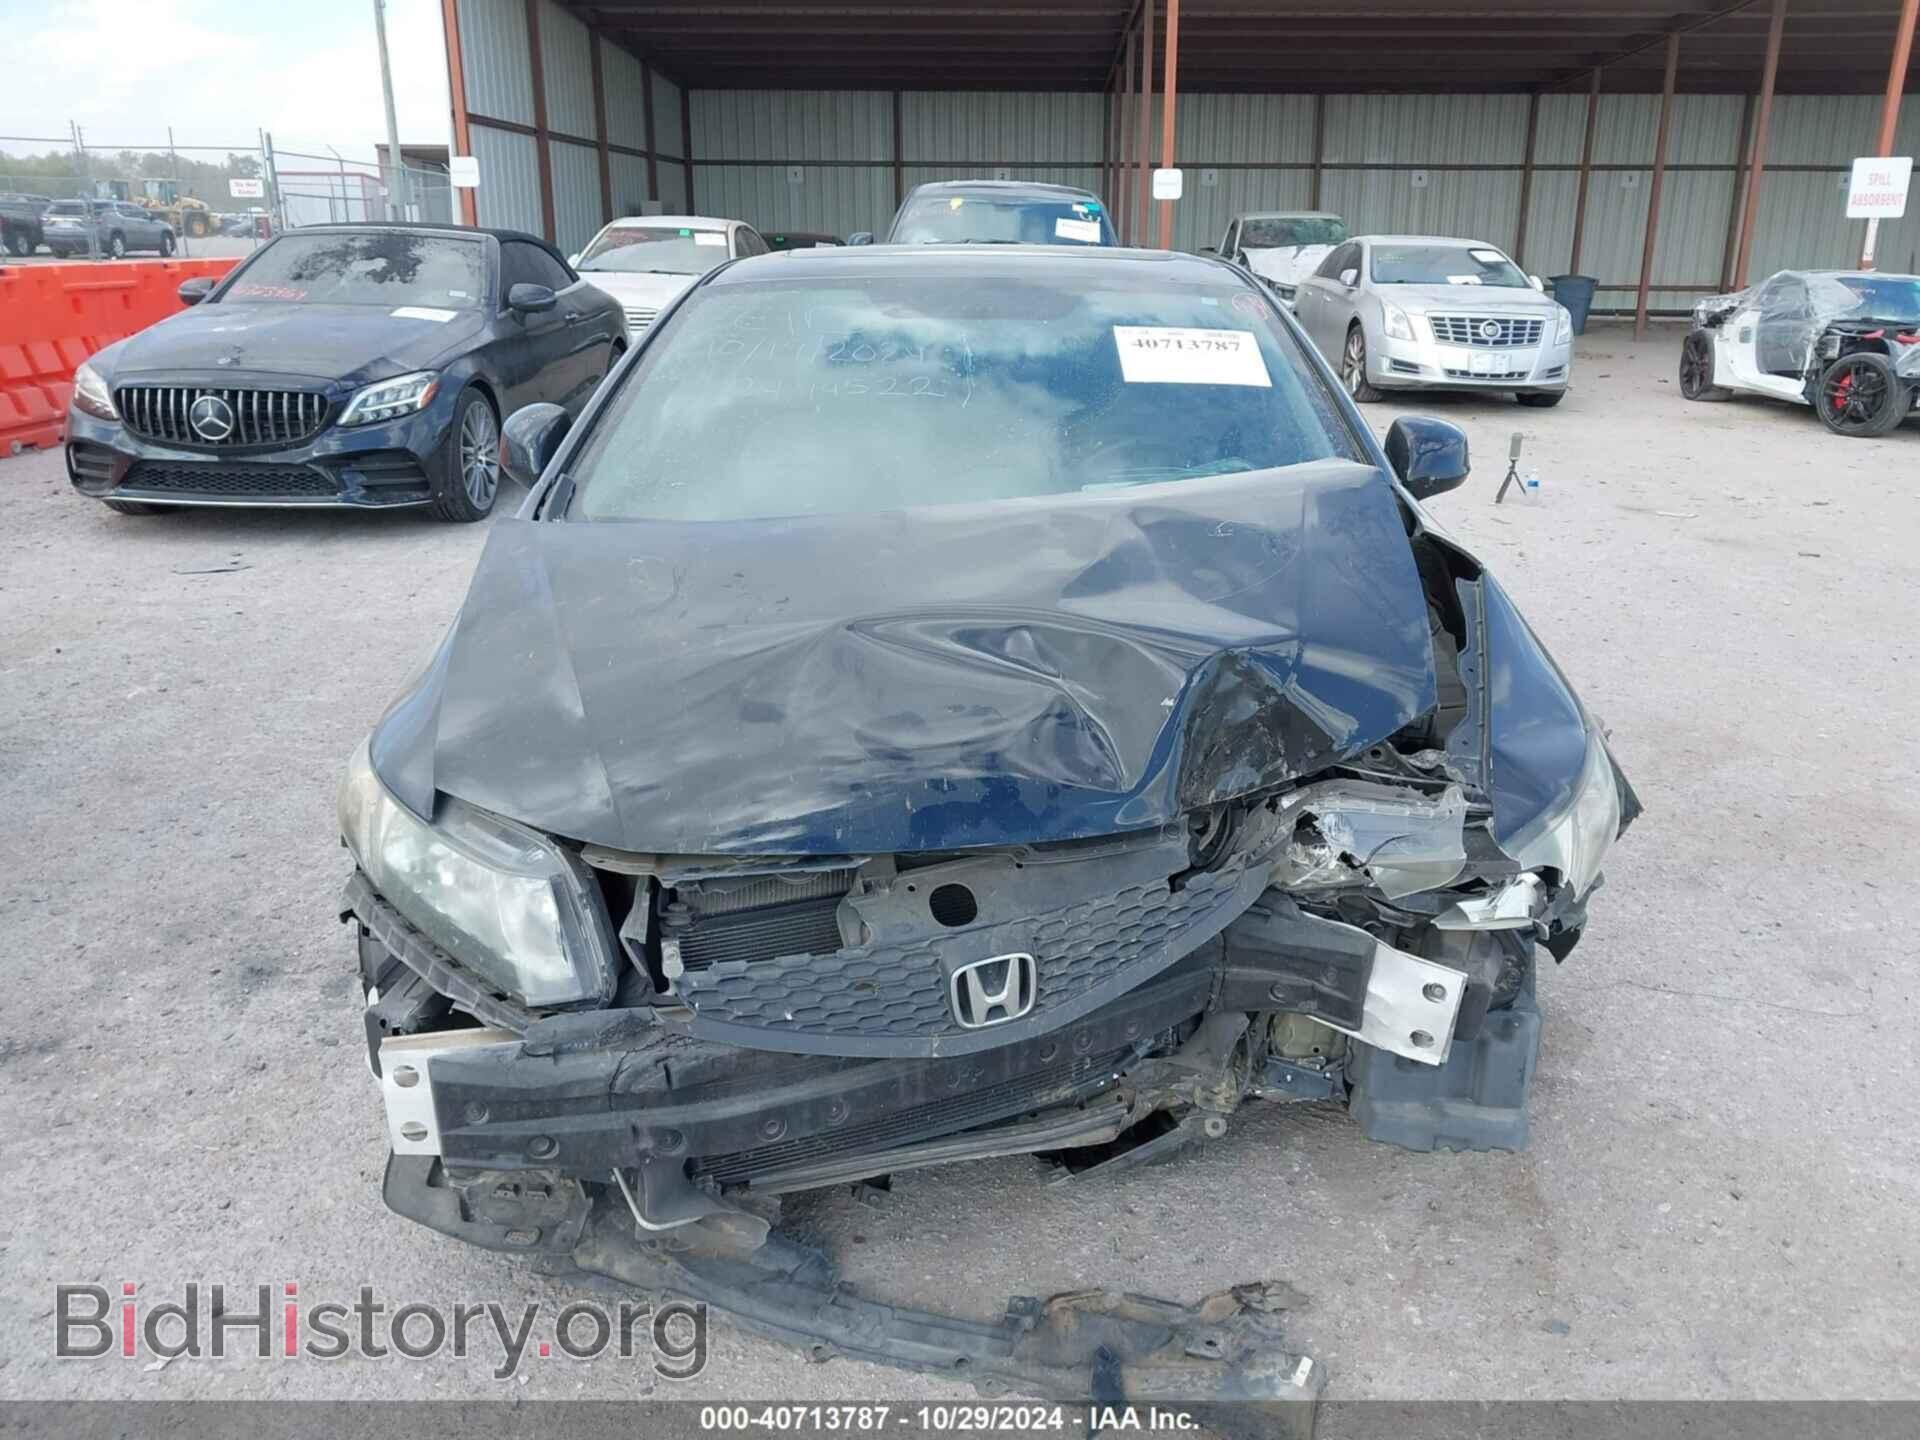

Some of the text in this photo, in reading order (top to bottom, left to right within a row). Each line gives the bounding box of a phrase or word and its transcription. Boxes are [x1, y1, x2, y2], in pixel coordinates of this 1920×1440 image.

[1867, 172, 1893, 186] SPILL
[1851, 193, 1904, 206] ABSORBENT
[1131, 338, 1241, 352] 40713787
